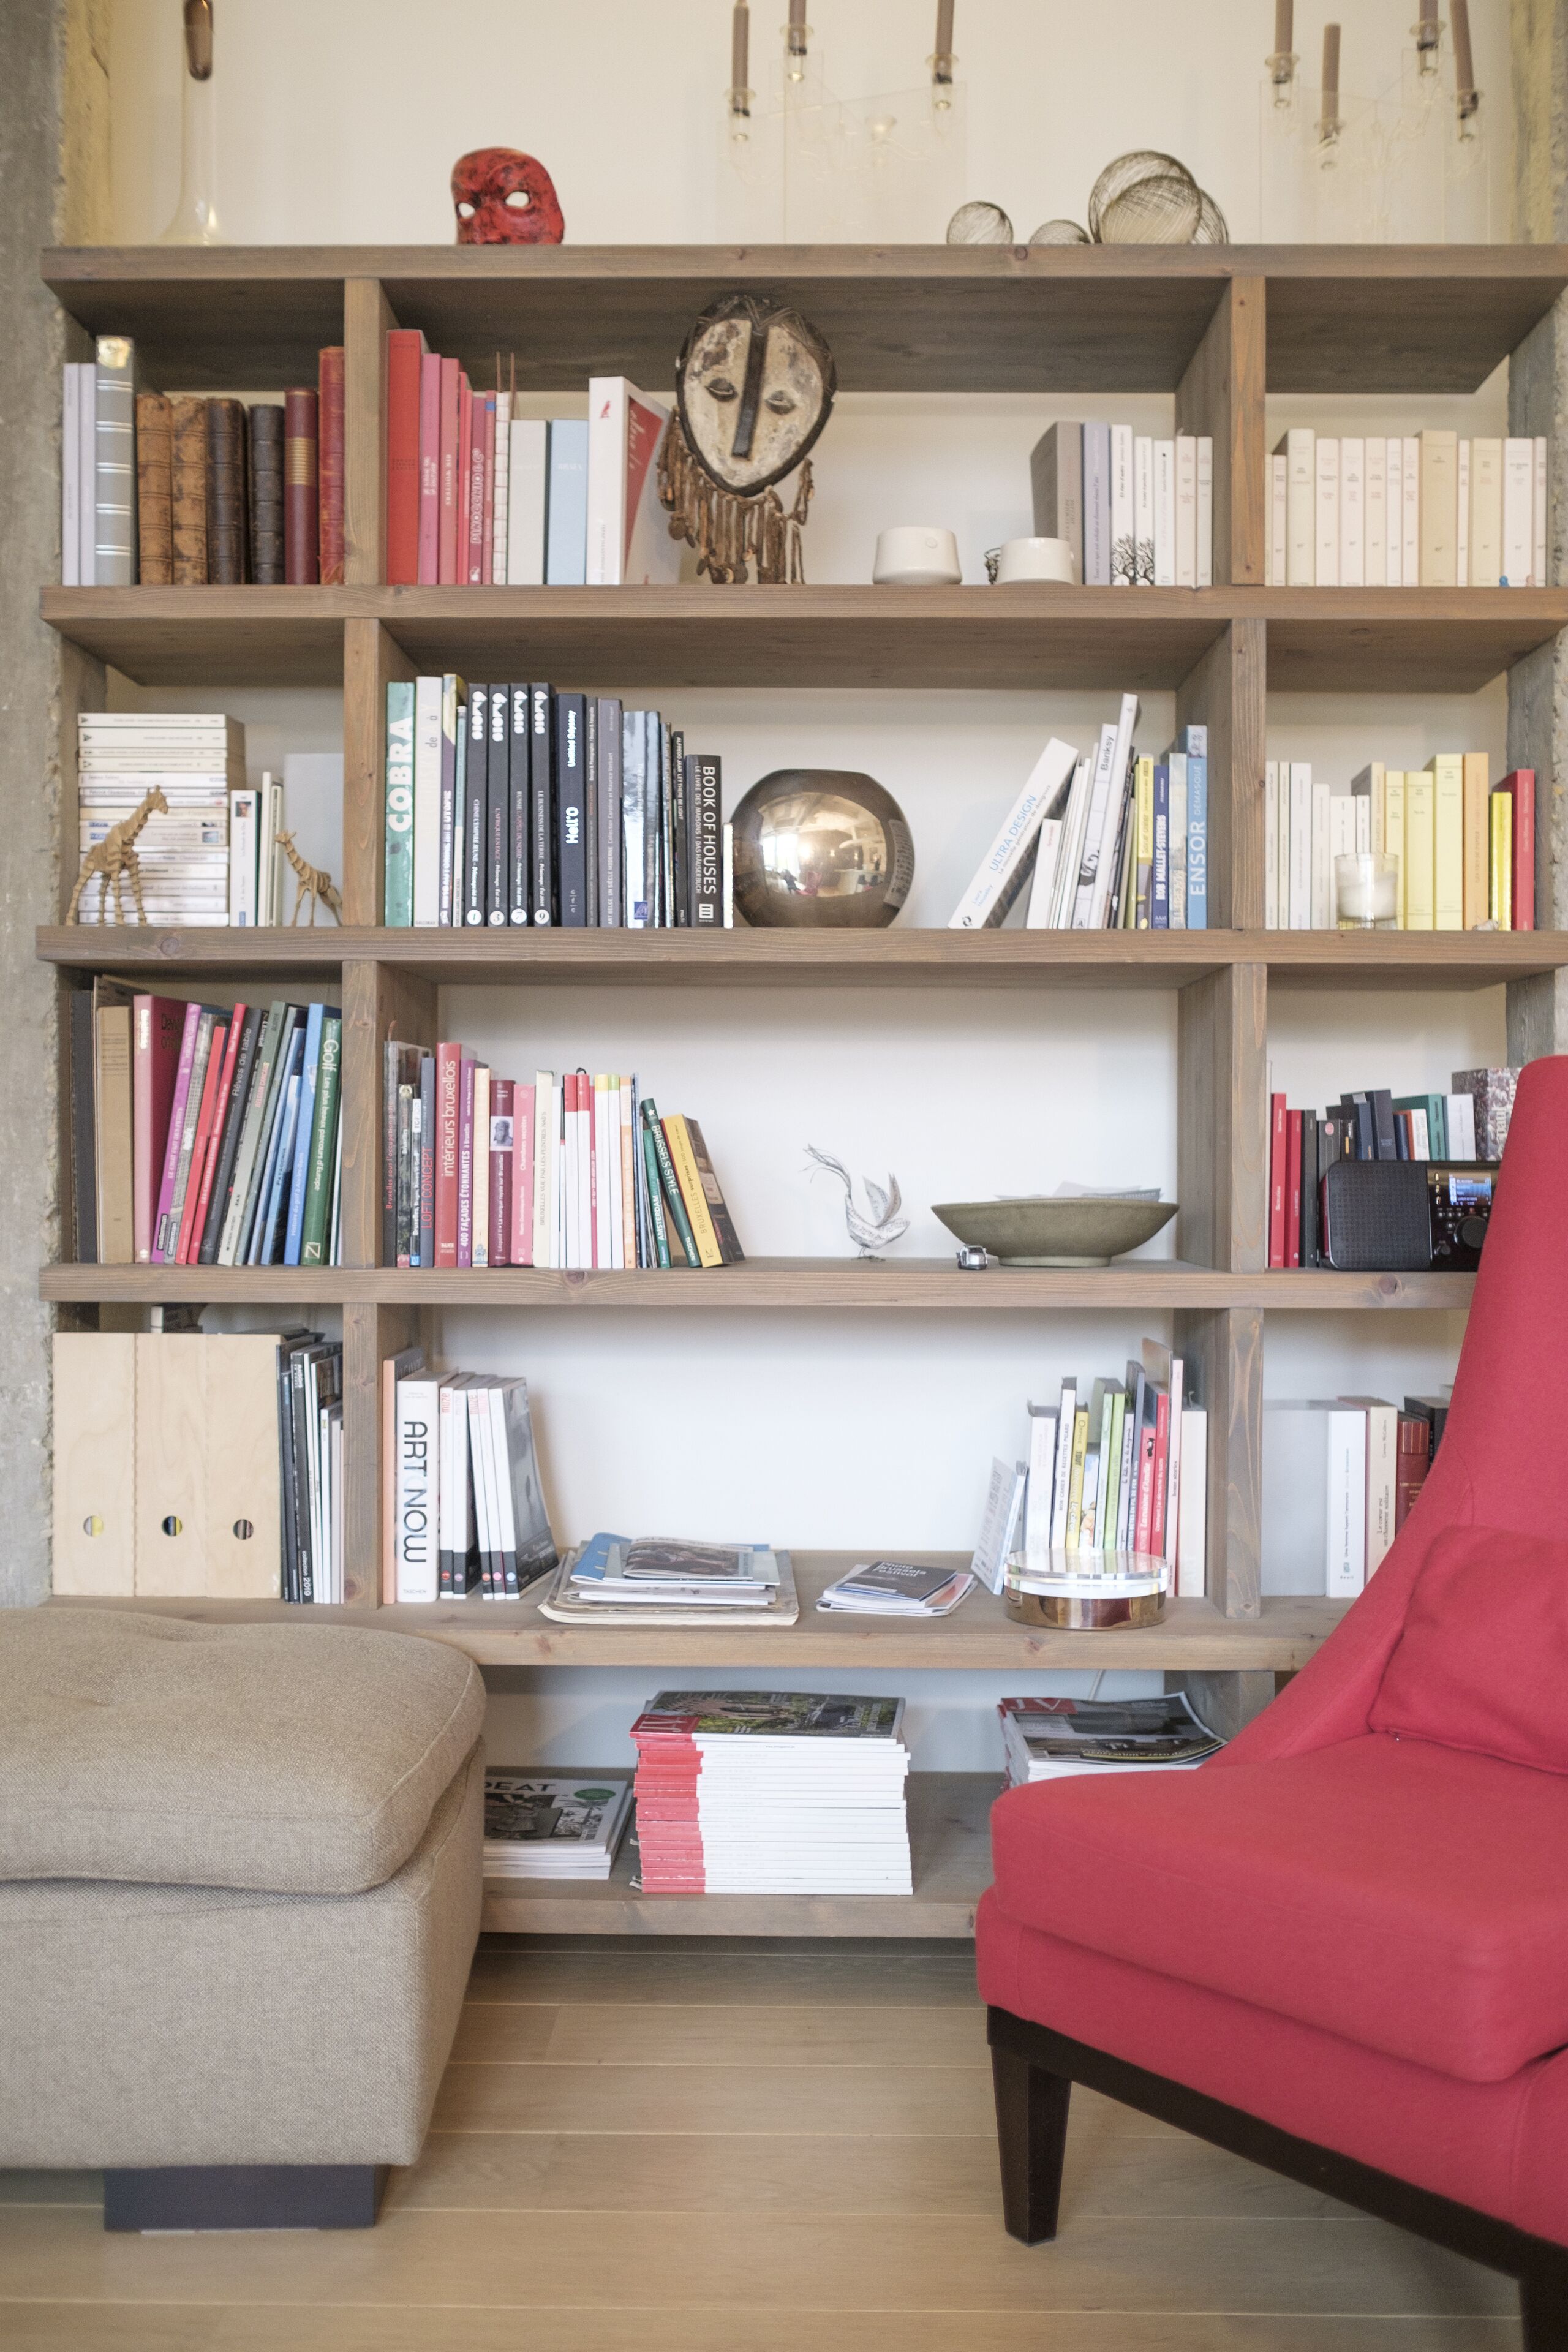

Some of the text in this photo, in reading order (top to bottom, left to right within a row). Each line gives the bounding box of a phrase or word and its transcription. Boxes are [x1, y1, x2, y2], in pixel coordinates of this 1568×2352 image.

[470, 473, 484, 543] PINOCCHIO
[425, 737, 437, 748] de
[567, 710, 577, 767] Untitled Odyssey
[1101, 735, 1115, 771] Banksy
[389, 717, 412, 832] COBRA
[516, 833, 522, 842] DU
[566, 807, 579, 844] Hell'O
[703, 766, 716, 894] BOOK OF HOUSES
[989, 795, 1036, 871] ULTRA DESIGN
[1003, 845, 1016, 867] nouvelle
[1031, 809, 1037, 818] de
[1156, 815, 1166, 900] ROB MALLET-STEVENS
[1190, 821, 1206, 895] ENSOR
[232, 1027, 252, 1097] Rêves de table
[312, 1038, 339, 1191] Golf Les plus beaux parcours d'Europe
[442, 1061, 455, 1177] intérieurs bruxellois
[386, 1120, 394, 1160] l'occupation
[649, 1124, 680, 1196] BRUSSELS STYLE
[421, 1147, 432, 1197] CONCEPT
[459, 1150, 470, 1197] ÉTONNANTES
[683, 1164, 696, 1191] surprises
[421, 1201, 432, 1229] LOFT
[461, 1200, 470, 1231] FAÇADES
[652, 1194, 665, 1240] AMSTERDAM
[690, 1191, 707, 1234] BRUXELLES
[441, 1393, 450, 1413] muze
[404, 1420, 428, 1562] ART NOW
[303, 1577, 312, 1596] 2019
